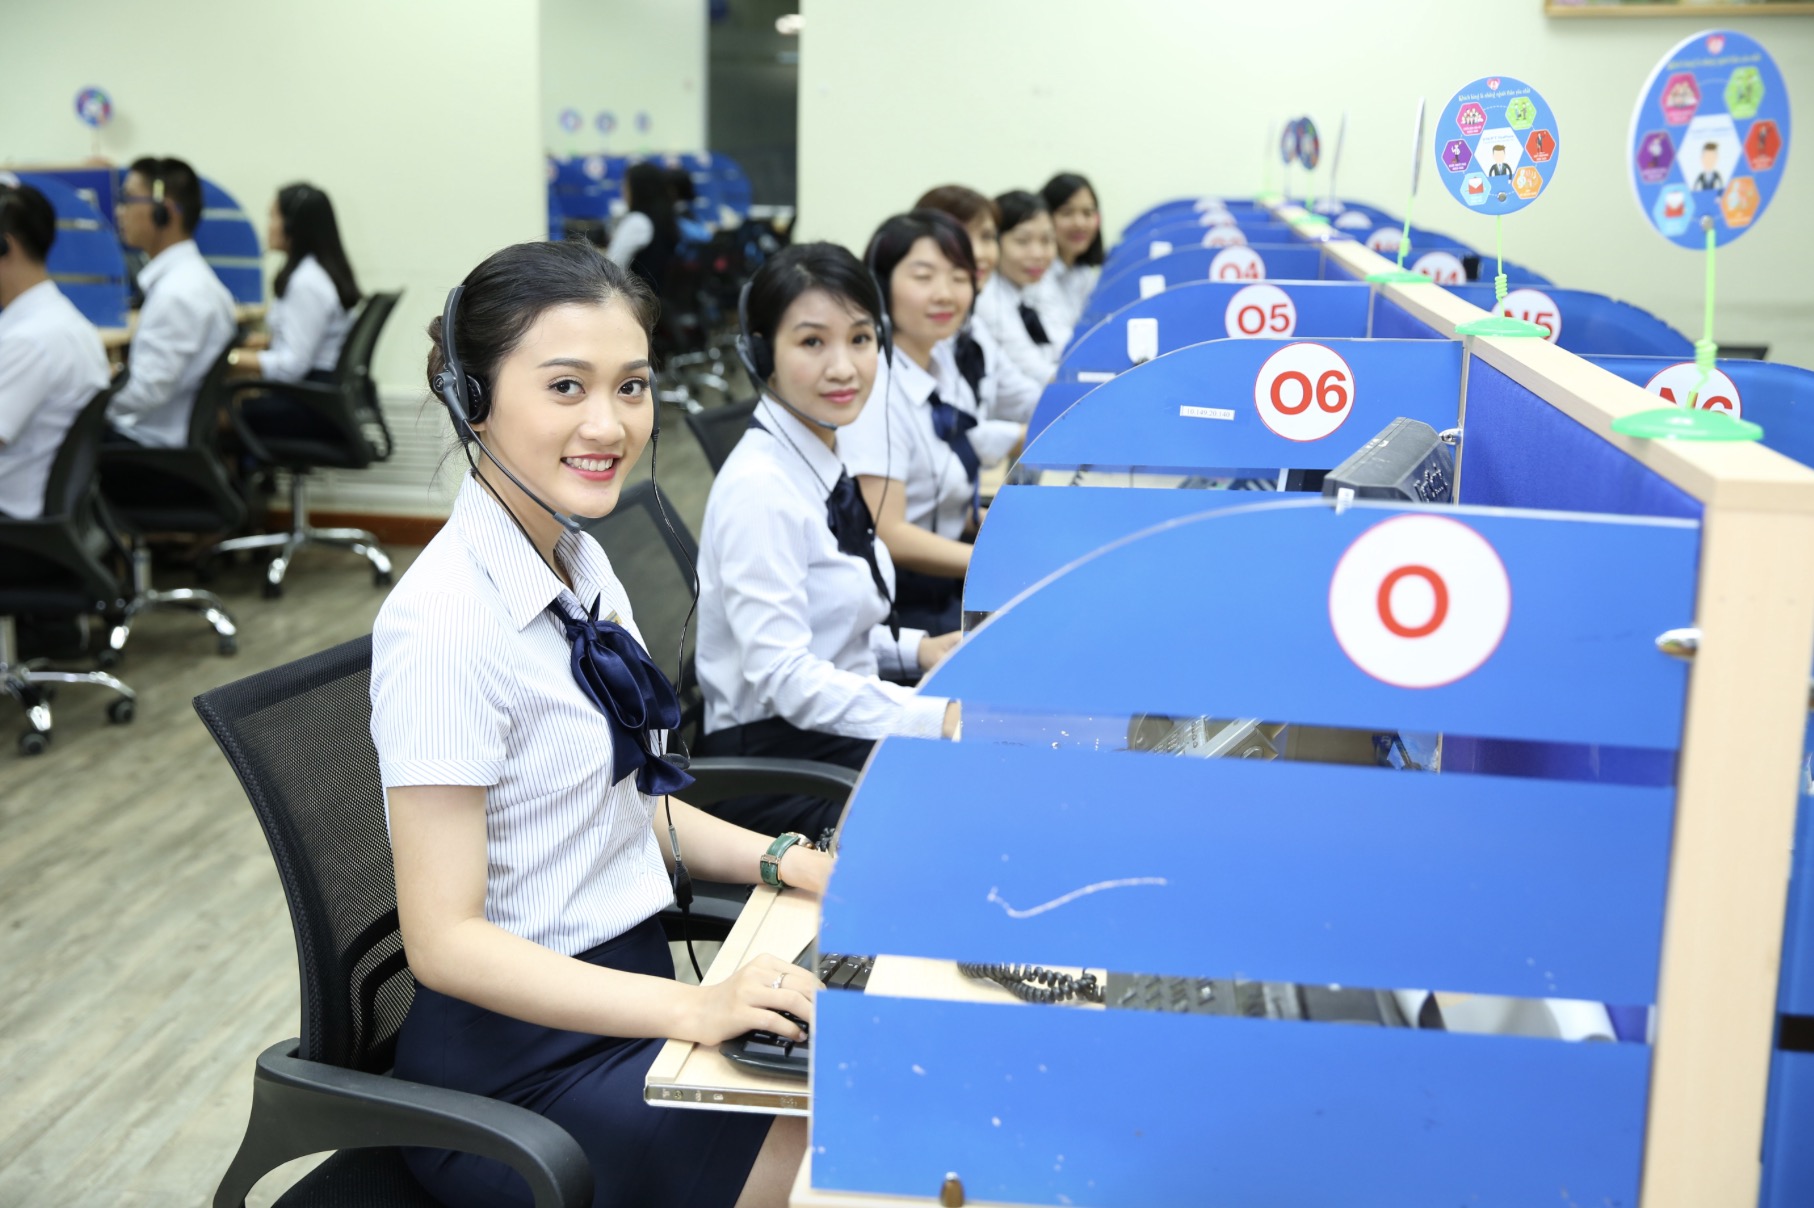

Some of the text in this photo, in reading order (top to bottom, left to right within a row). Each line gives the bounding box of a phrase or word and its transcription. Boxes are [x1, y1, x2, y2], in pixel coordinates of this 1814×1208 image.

[1237, 303, 1290, 335] O5
[1270, 369, 1348, 416] O6
[1377, 564, 1449, 639] O
